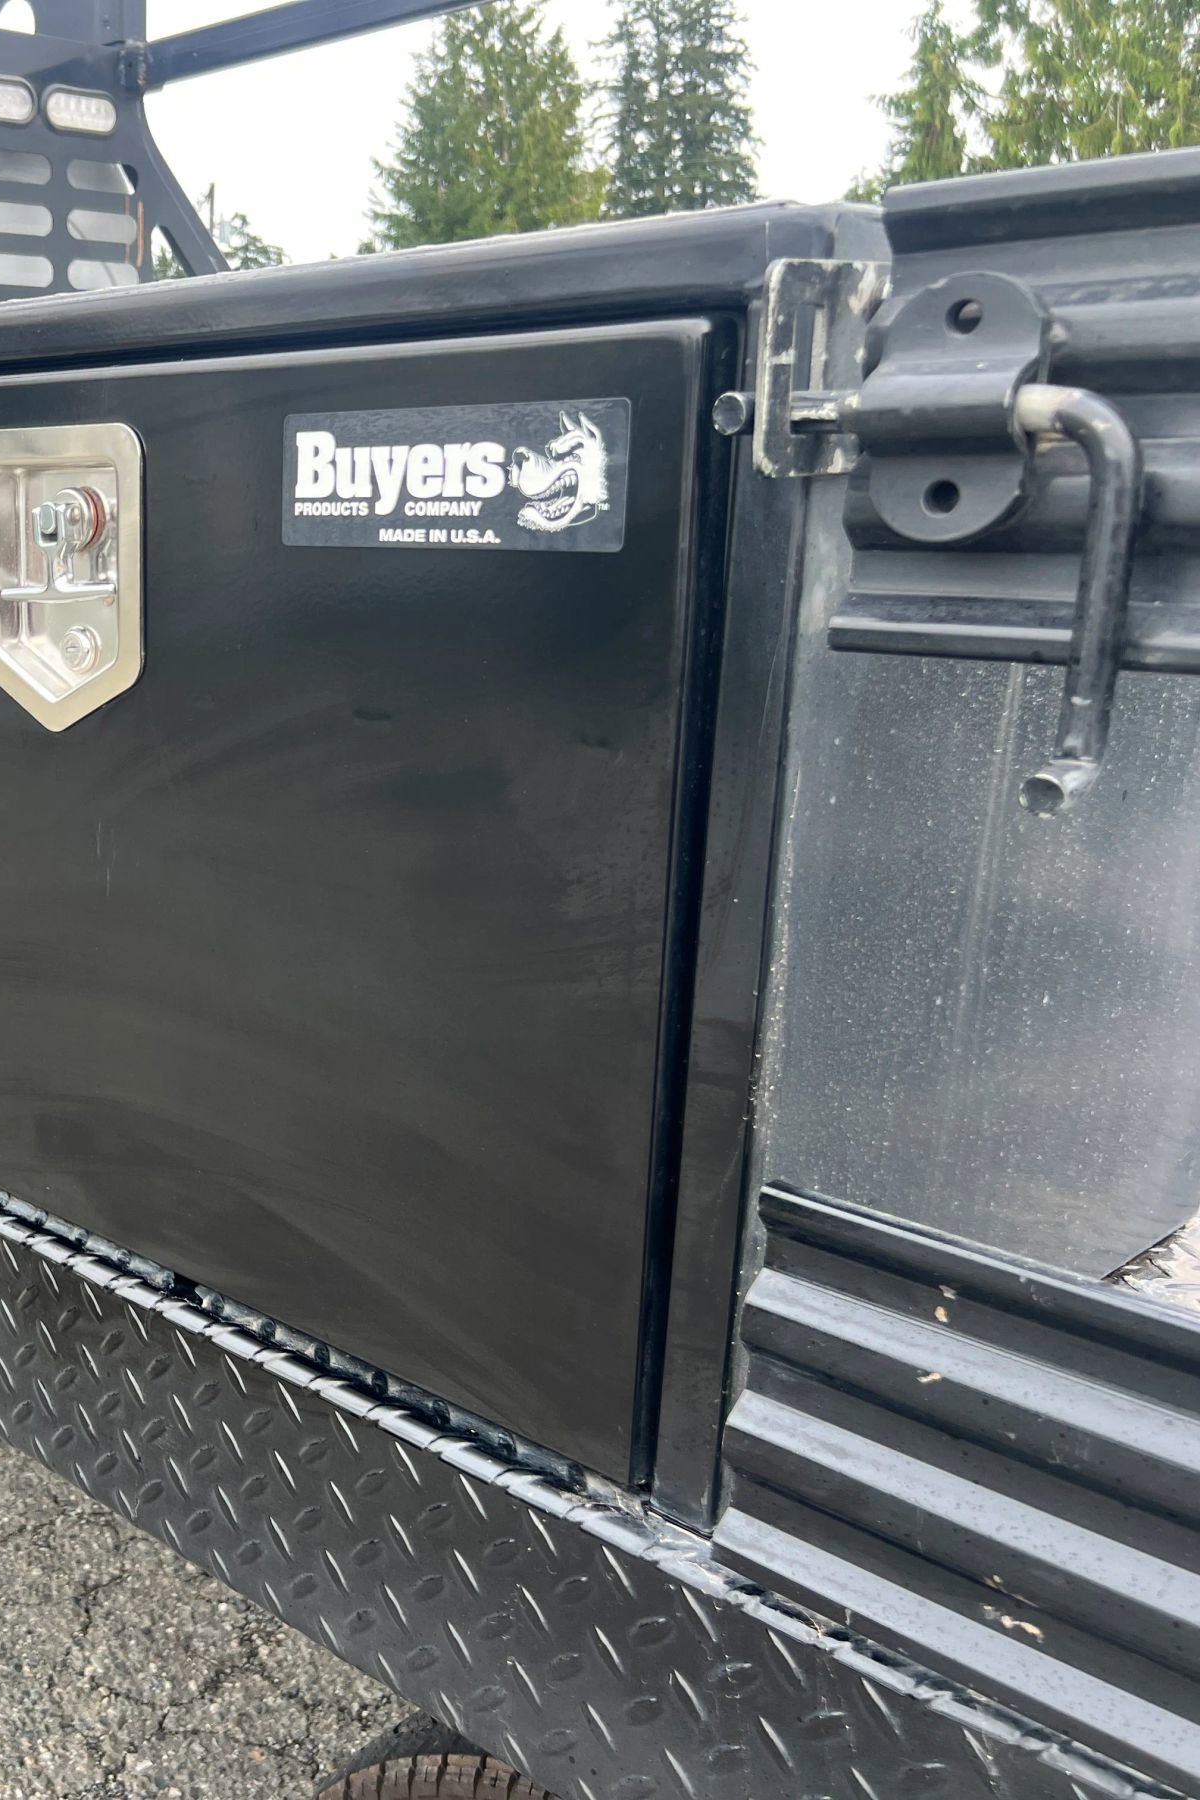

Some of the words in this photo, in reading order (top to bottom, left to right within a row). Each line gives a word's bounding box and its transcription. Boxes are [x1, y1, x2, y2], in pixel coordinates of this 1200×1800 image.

[295, 431, 506, 516] Buyers
[294, 501, 369, 516] PRODUCTS
[404, 501, 483, 516] COMPANY
[379, 528, 426, 542] MADE
[429, 529, 448, 542] IN
[450, 529, 501, 544] U.S.A.
